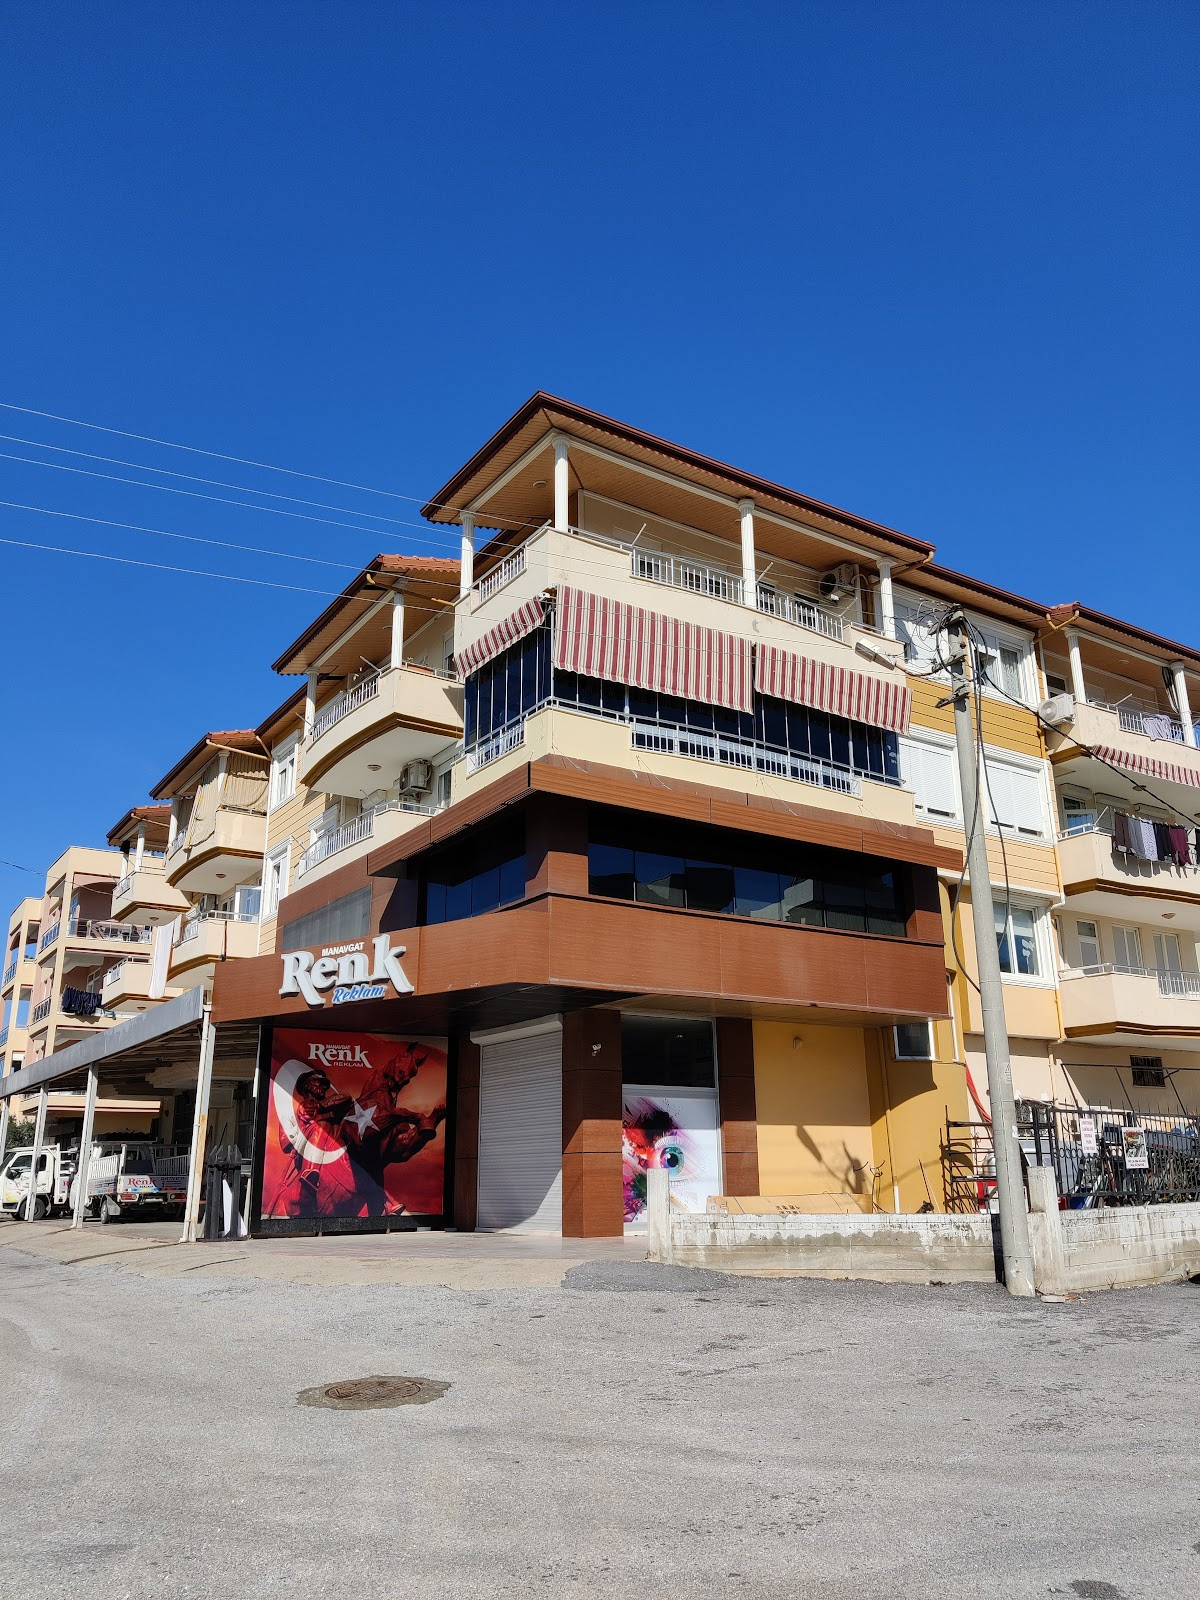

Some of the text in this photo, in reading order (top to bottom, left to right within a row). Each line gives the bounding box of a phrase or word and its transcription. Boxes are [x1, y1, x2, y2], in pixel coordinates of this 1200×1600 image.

[322, 942, 365, 956] MANAVGAT
[279, 934, 415, 1006] Renk
[332, 985, 386, 1004] Reklam
[308, 1043, 373, 1068] Renk
[127, 1177, 156, 1188] Renk
